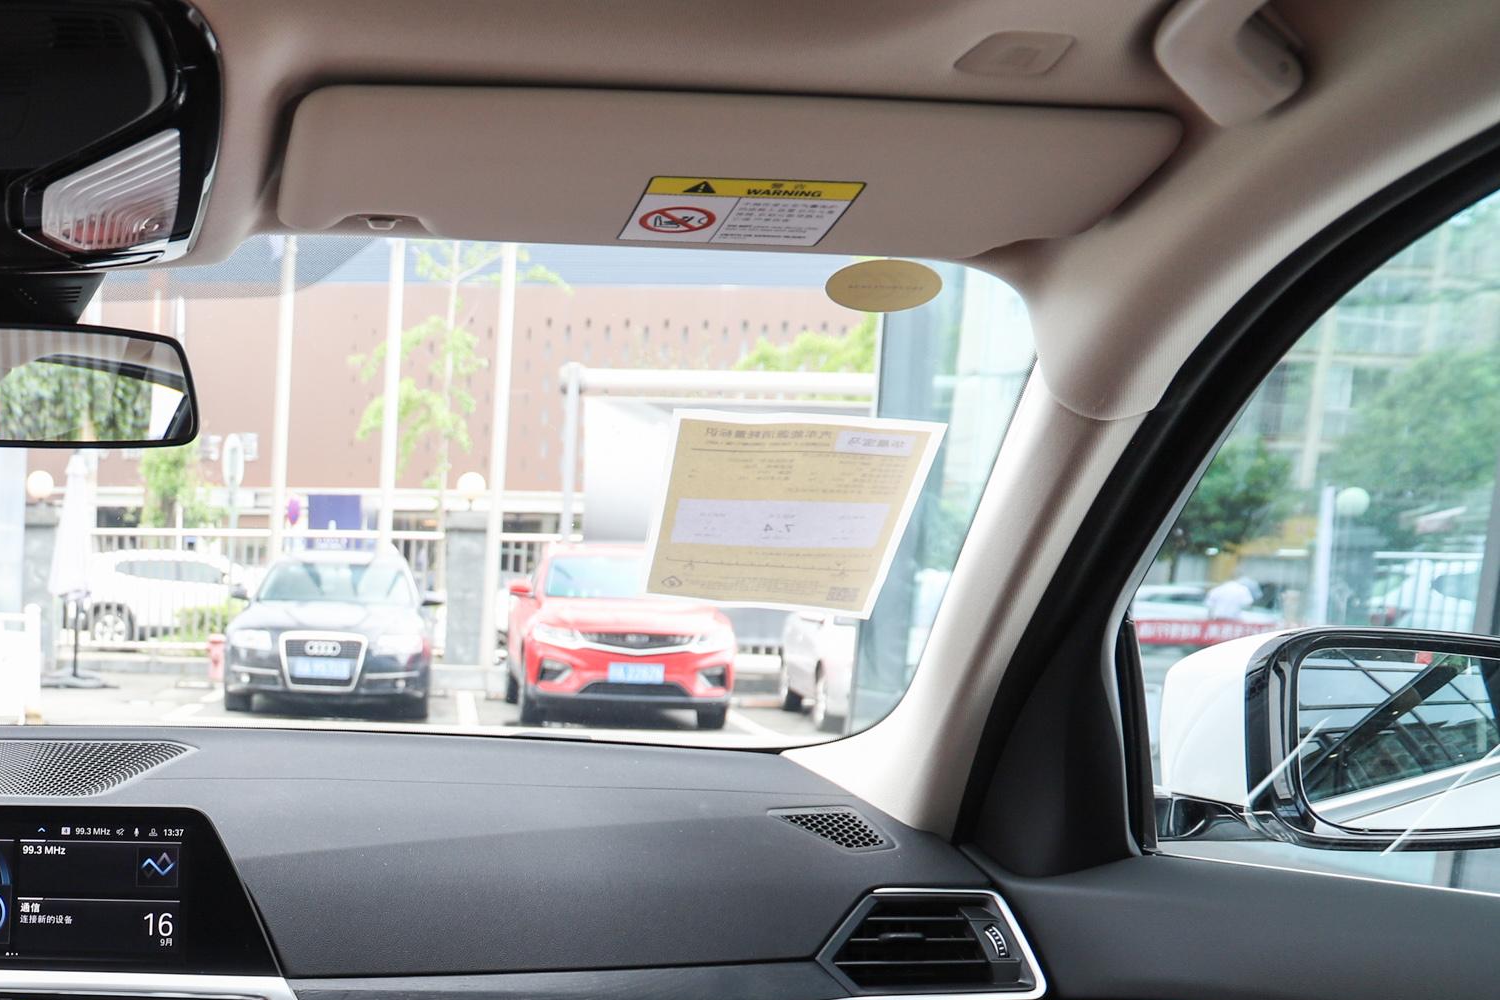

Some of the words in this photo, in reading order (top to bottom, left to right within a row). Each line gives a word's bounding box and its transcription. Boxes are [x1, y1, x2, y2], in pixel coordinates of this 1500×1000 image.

[746, 188, 823, 198] WARNING
[75, 827, 92, 836] 99.3
[92, 827, 111, 836] MHz
[163, 828, 185, 837] 13:37
[22, 845, 43, 855] 99.3
[44, 845, 66, 855] MHz
[19, 902, 41, 913] 通信
[19, 914, 73, 924] 连接新的设备
[143, 912, 174, 937] 16
[159, 937, 173, 947] 9月
